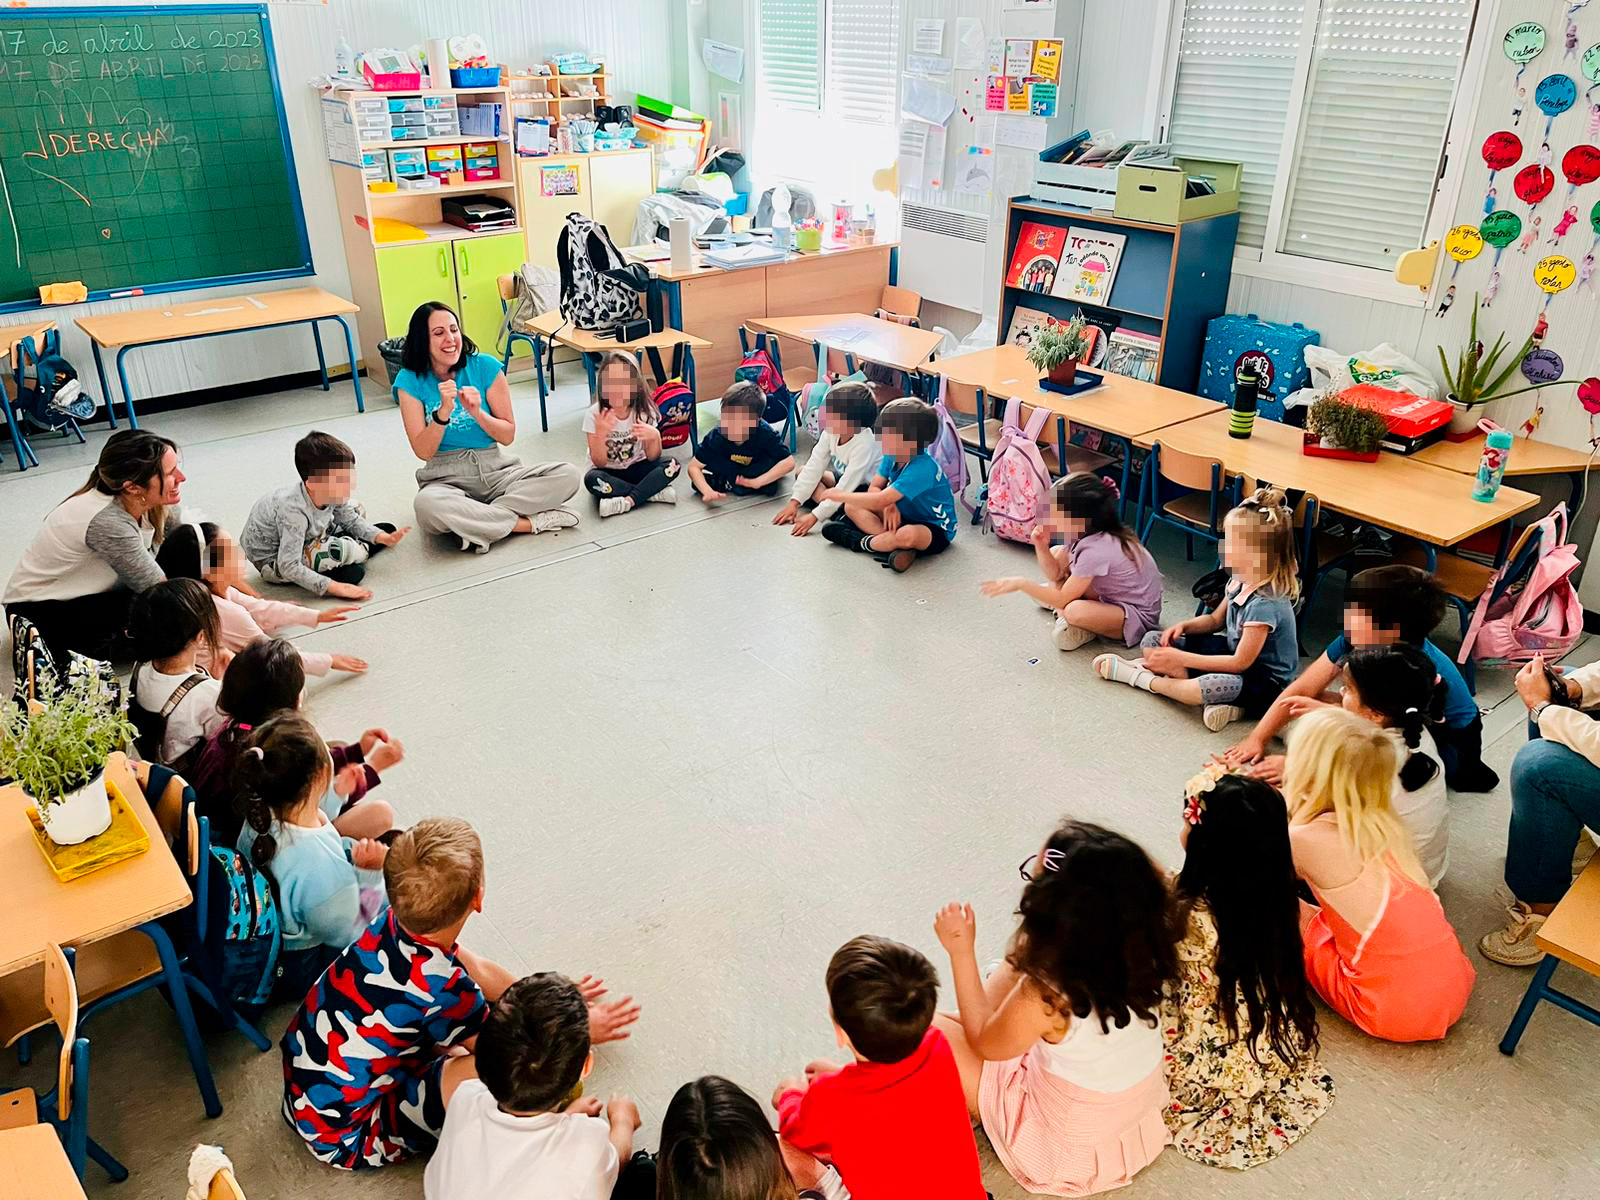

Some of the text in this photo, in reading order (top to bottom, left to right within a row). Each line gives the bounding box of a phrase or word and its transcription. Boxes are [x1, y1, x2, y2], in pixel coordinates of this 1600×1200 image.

[0, 23, 262, 57] 17 de abril de 2023
[48, 60, 82, 86] DE
[100, 56, 174, 82] ABRIL
[181, 53, 208, 76] DE
[49, 128, 168, 157] DERECHA
